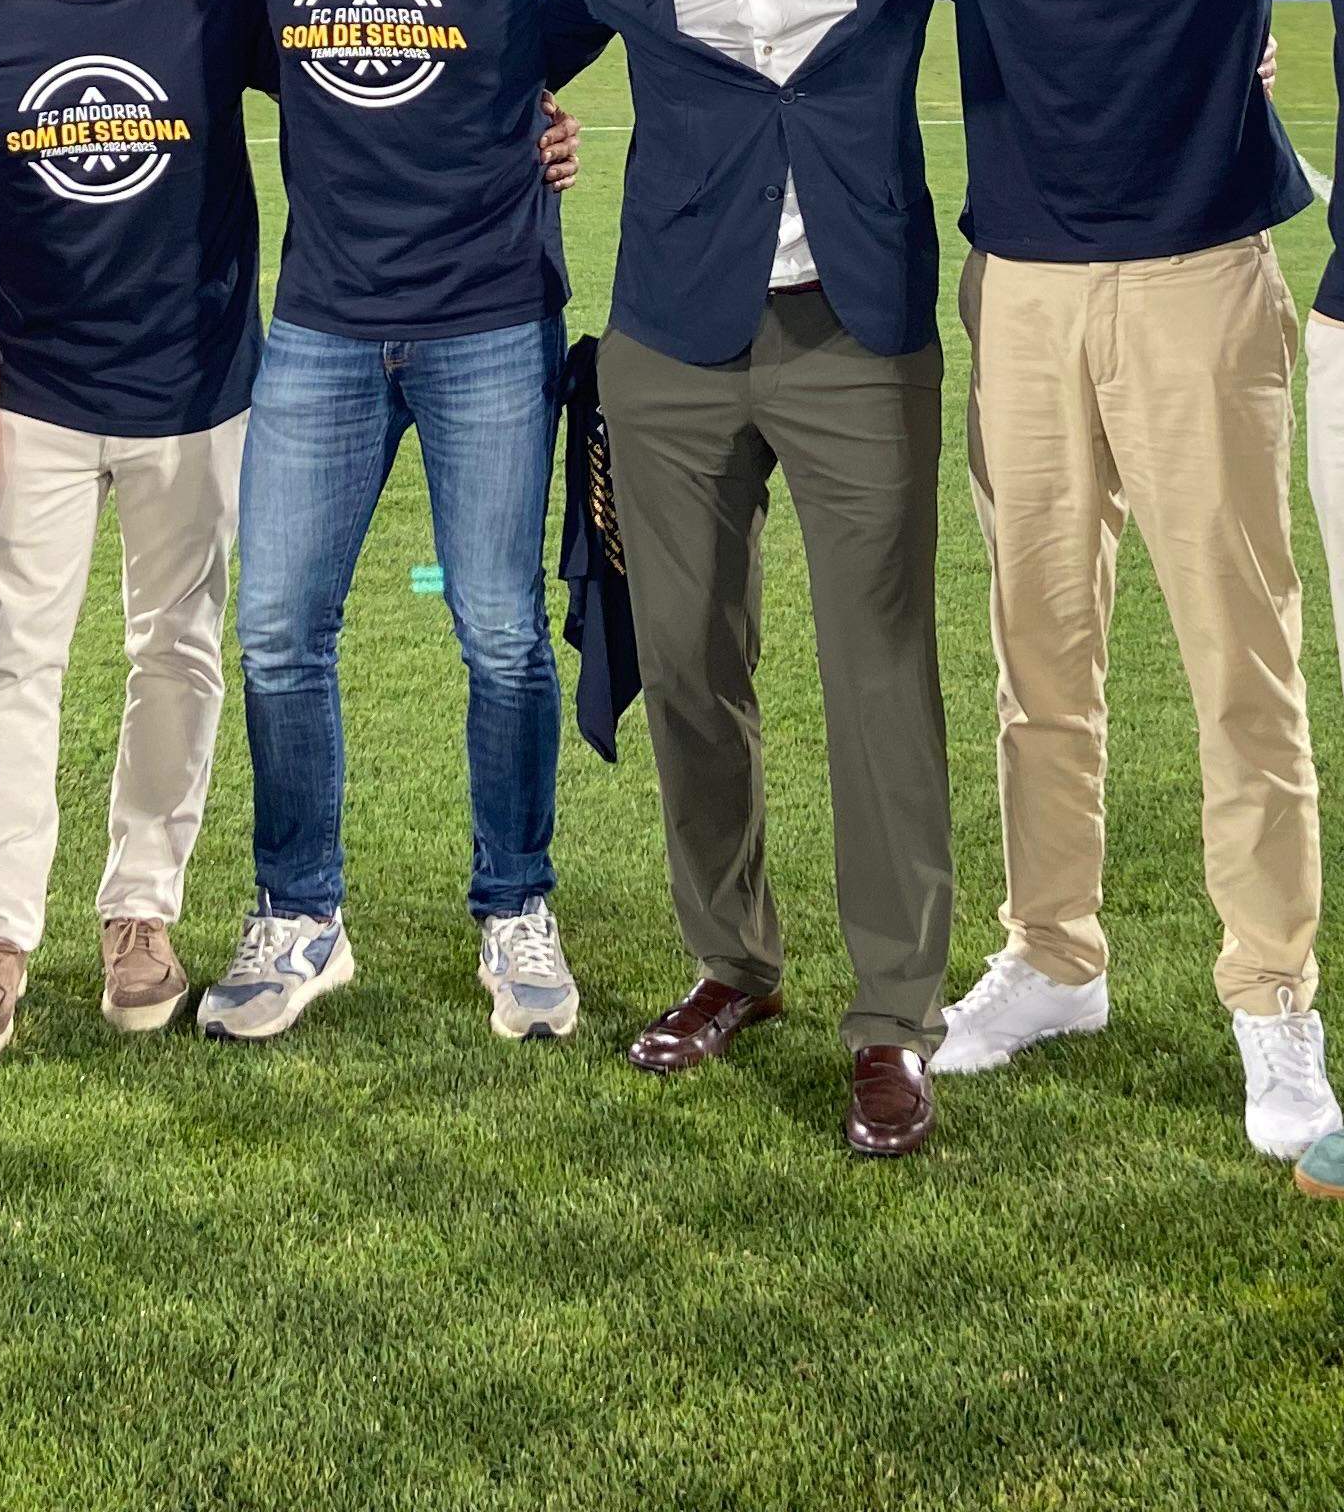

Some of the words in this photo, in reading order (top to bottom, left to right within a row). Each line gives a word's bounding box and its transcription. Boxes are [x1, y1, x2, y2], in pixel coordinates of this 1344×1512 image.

[310, 9, 331, 25] FC
[334, 8, 425, 25] ANDORRA
[282, 24, 328, 49] SOM
[333, 23, 362, 47] DE
[366, 24, 468, 49] SEGONA
[310, 47, 373, 59] TEMPORADA
[37, 110, 59, 127] FC
[62, 104, 152, 125] ANDORRA
[6, 126, 58, 153] SOM
[61, 121, 91, 145] DE
[94, 119, 191, 144] SEGONA
[40, 143, 103, 159] TEMPORADA
